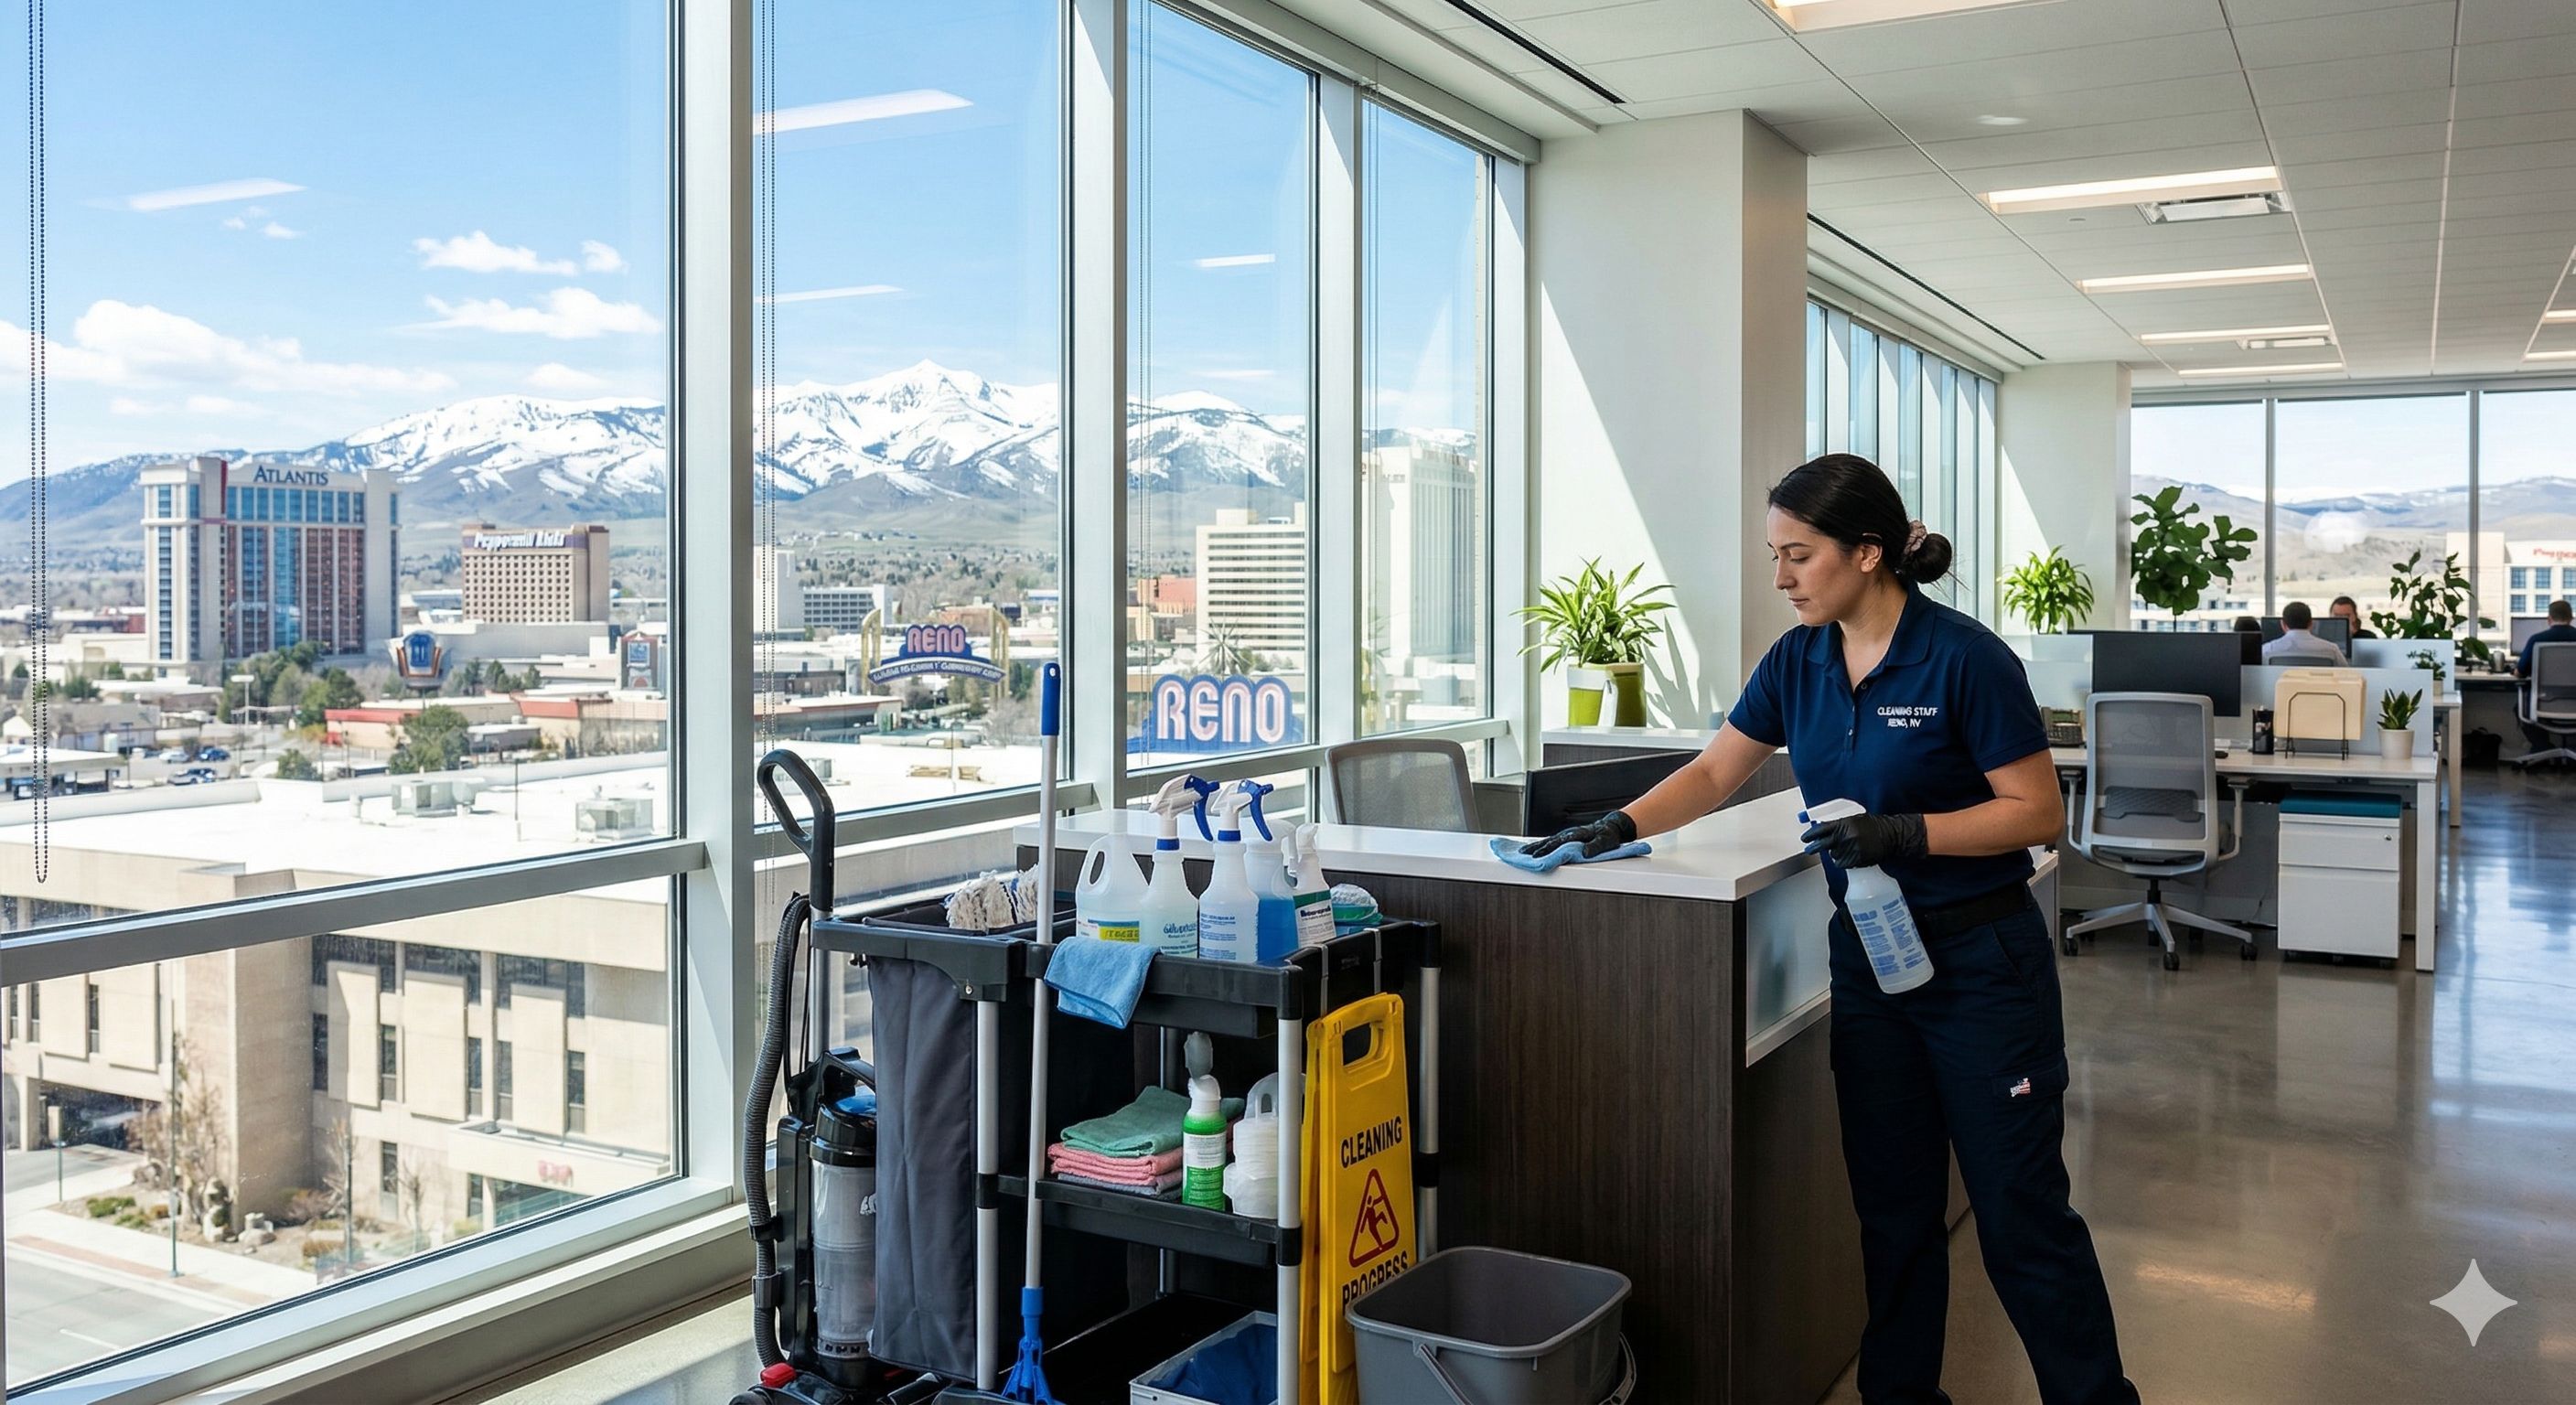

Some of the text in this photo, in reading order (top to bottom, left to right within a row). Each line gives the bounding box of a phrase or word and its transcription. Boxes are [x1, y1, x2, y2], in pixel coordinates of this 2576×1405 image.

[253, 465, 328, 486] ATLANTIS
[907, 627, 965, 653] RENO
[1157, 681, 1285, 744] RENO
[1909, 718, 1922, 728] NV
[1341, 1115, 1402, 1169] CLEANING
